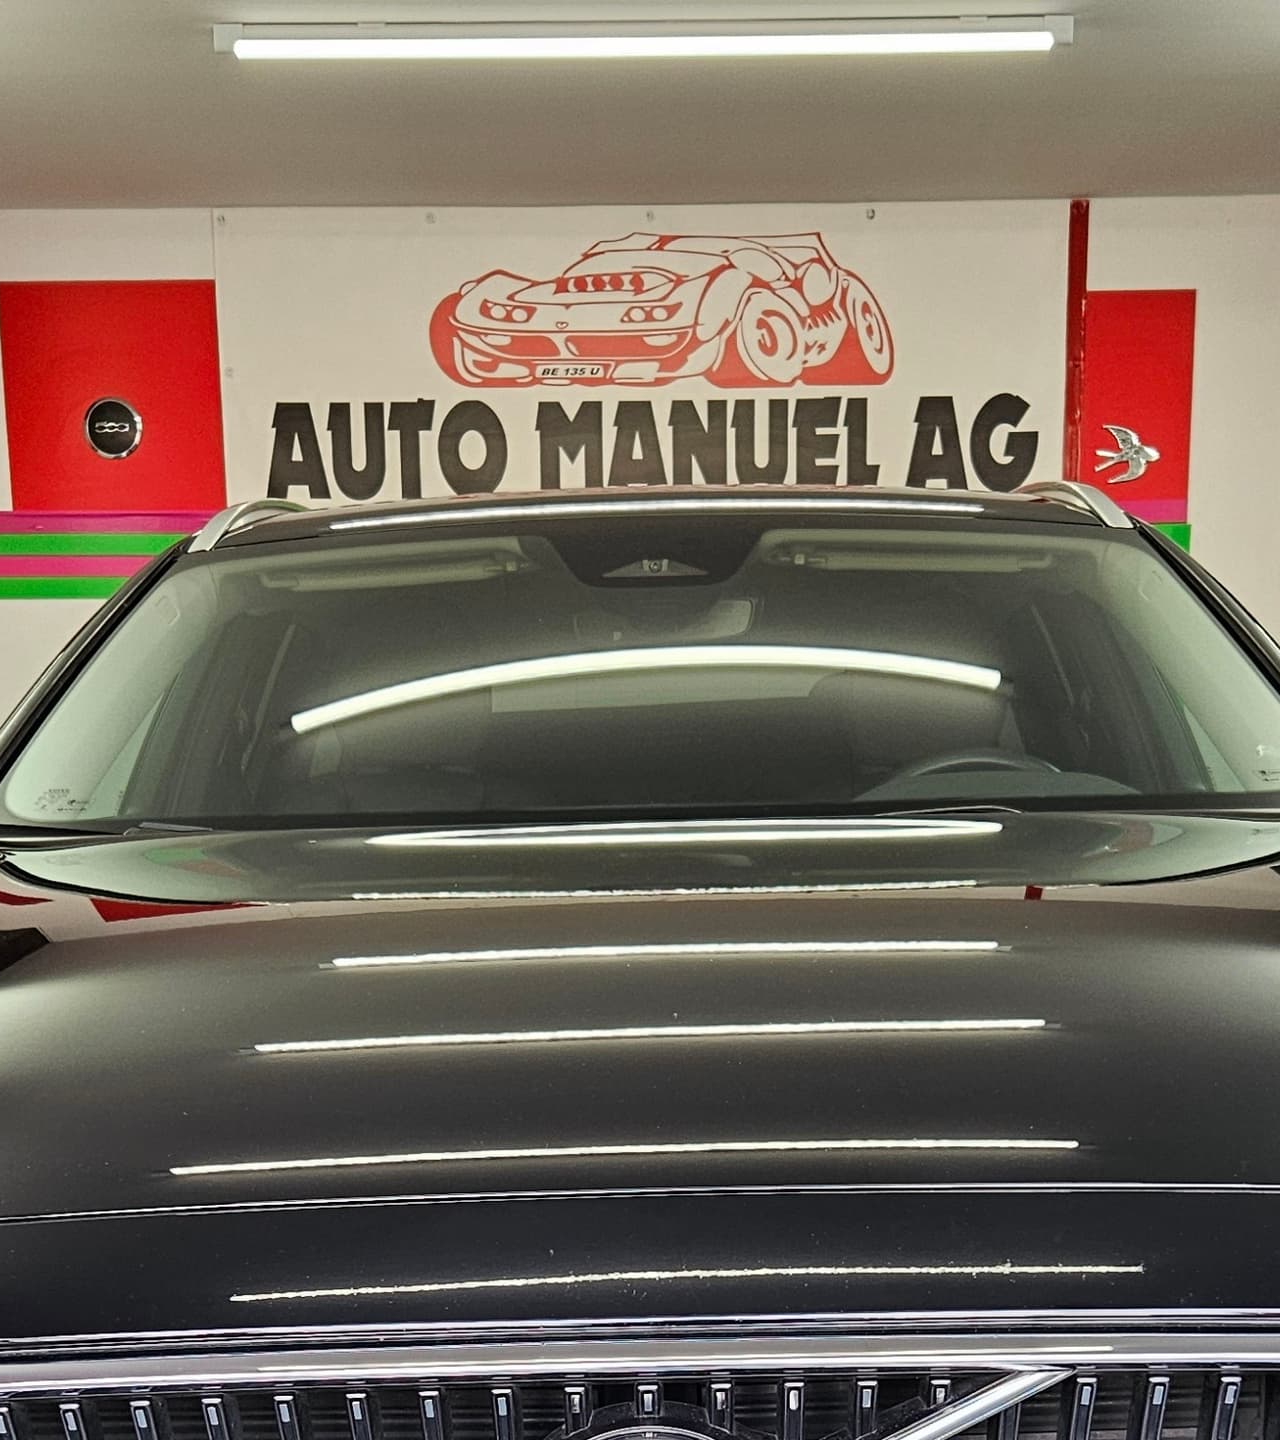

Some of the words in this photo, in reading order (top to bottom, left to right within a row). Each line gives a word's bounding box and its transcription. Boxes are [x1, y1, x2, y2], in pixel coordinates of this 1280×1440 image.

[541, 368, 559, 376] BE
[564, 368, 586, 376] 135
[590, 368, 600, 376] U
[268, 397, 508, 500] AUTO
[535, 396, 880, 489] MANUEL
[907, 392, 1039, 494] AG
